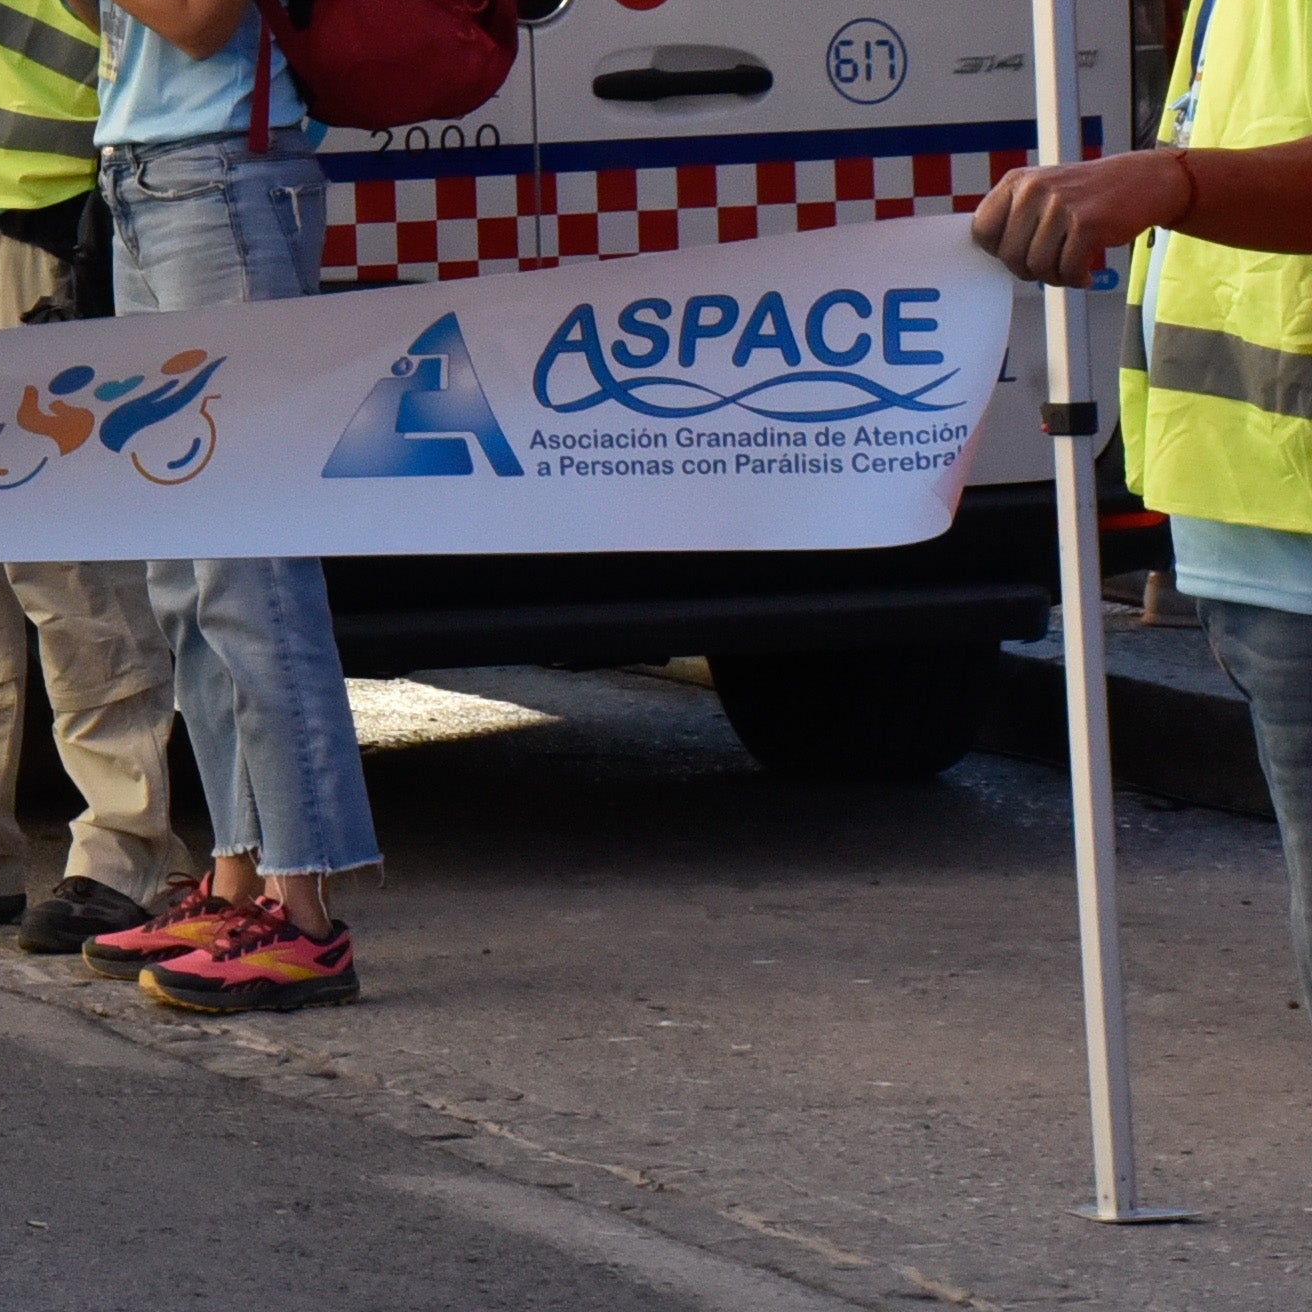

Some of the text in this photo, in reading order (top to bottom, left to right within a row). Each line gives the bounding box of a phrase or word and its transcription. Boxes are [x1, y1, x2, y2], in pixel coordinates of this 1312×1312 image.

[531, 286, 946, 412] ASPACE
[529, 420, 969, 451] Asociación Granadina de Atención
[536, 459, 553, 478] a
[559, 454, 675, 477] Personas
[681, 458, 728, 476] con
[734, 450, 844, 475] Parálisis
